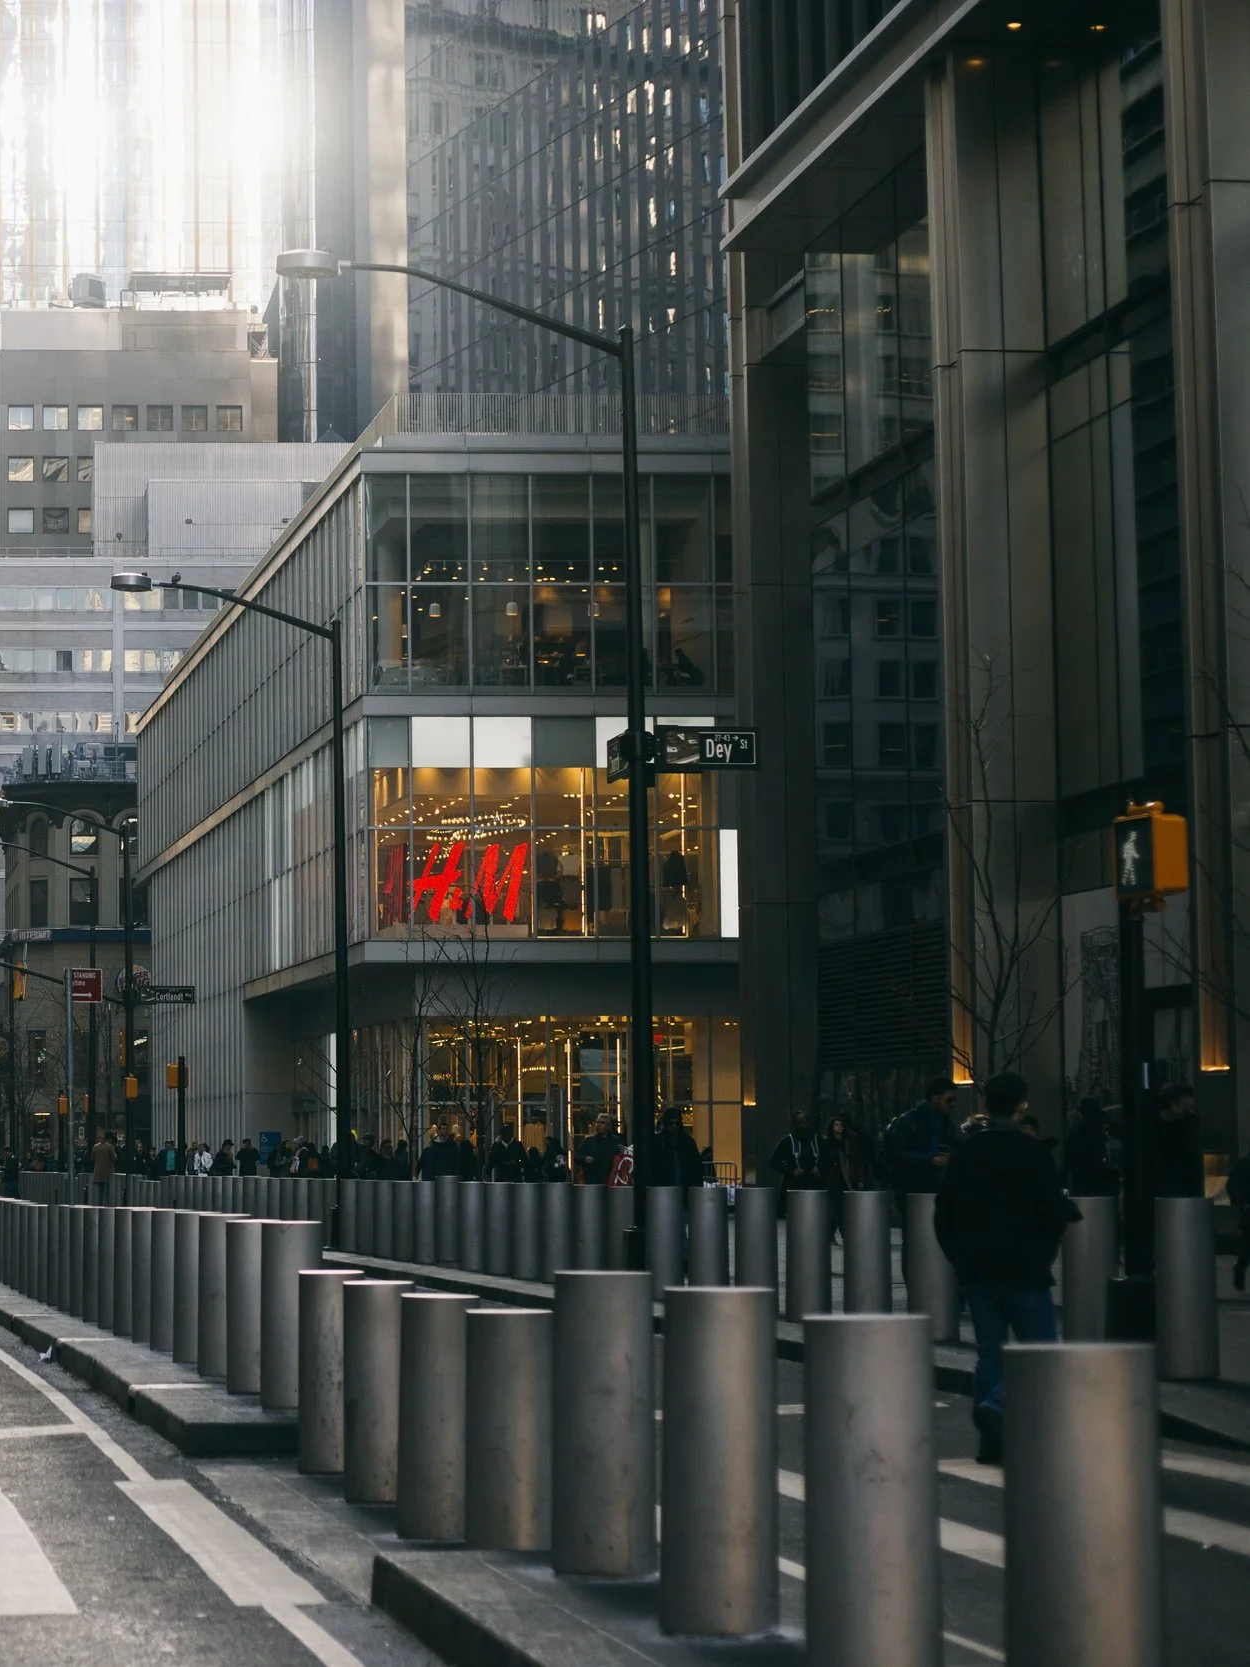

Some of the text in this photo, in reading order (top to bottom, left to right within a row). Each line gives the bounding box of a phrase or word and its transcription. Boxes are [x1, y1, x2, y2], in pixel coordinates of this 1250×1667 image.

[714, 734, 731, 743] 27-43
[705, 738, 749, 764] Dey St
[407, 841, 528, 922] H&M
[18, 929, 51, 941] INTERNET
[73, 971, 97, 980] STANDING
[155, 991, 184, 1002] Cortlandt
